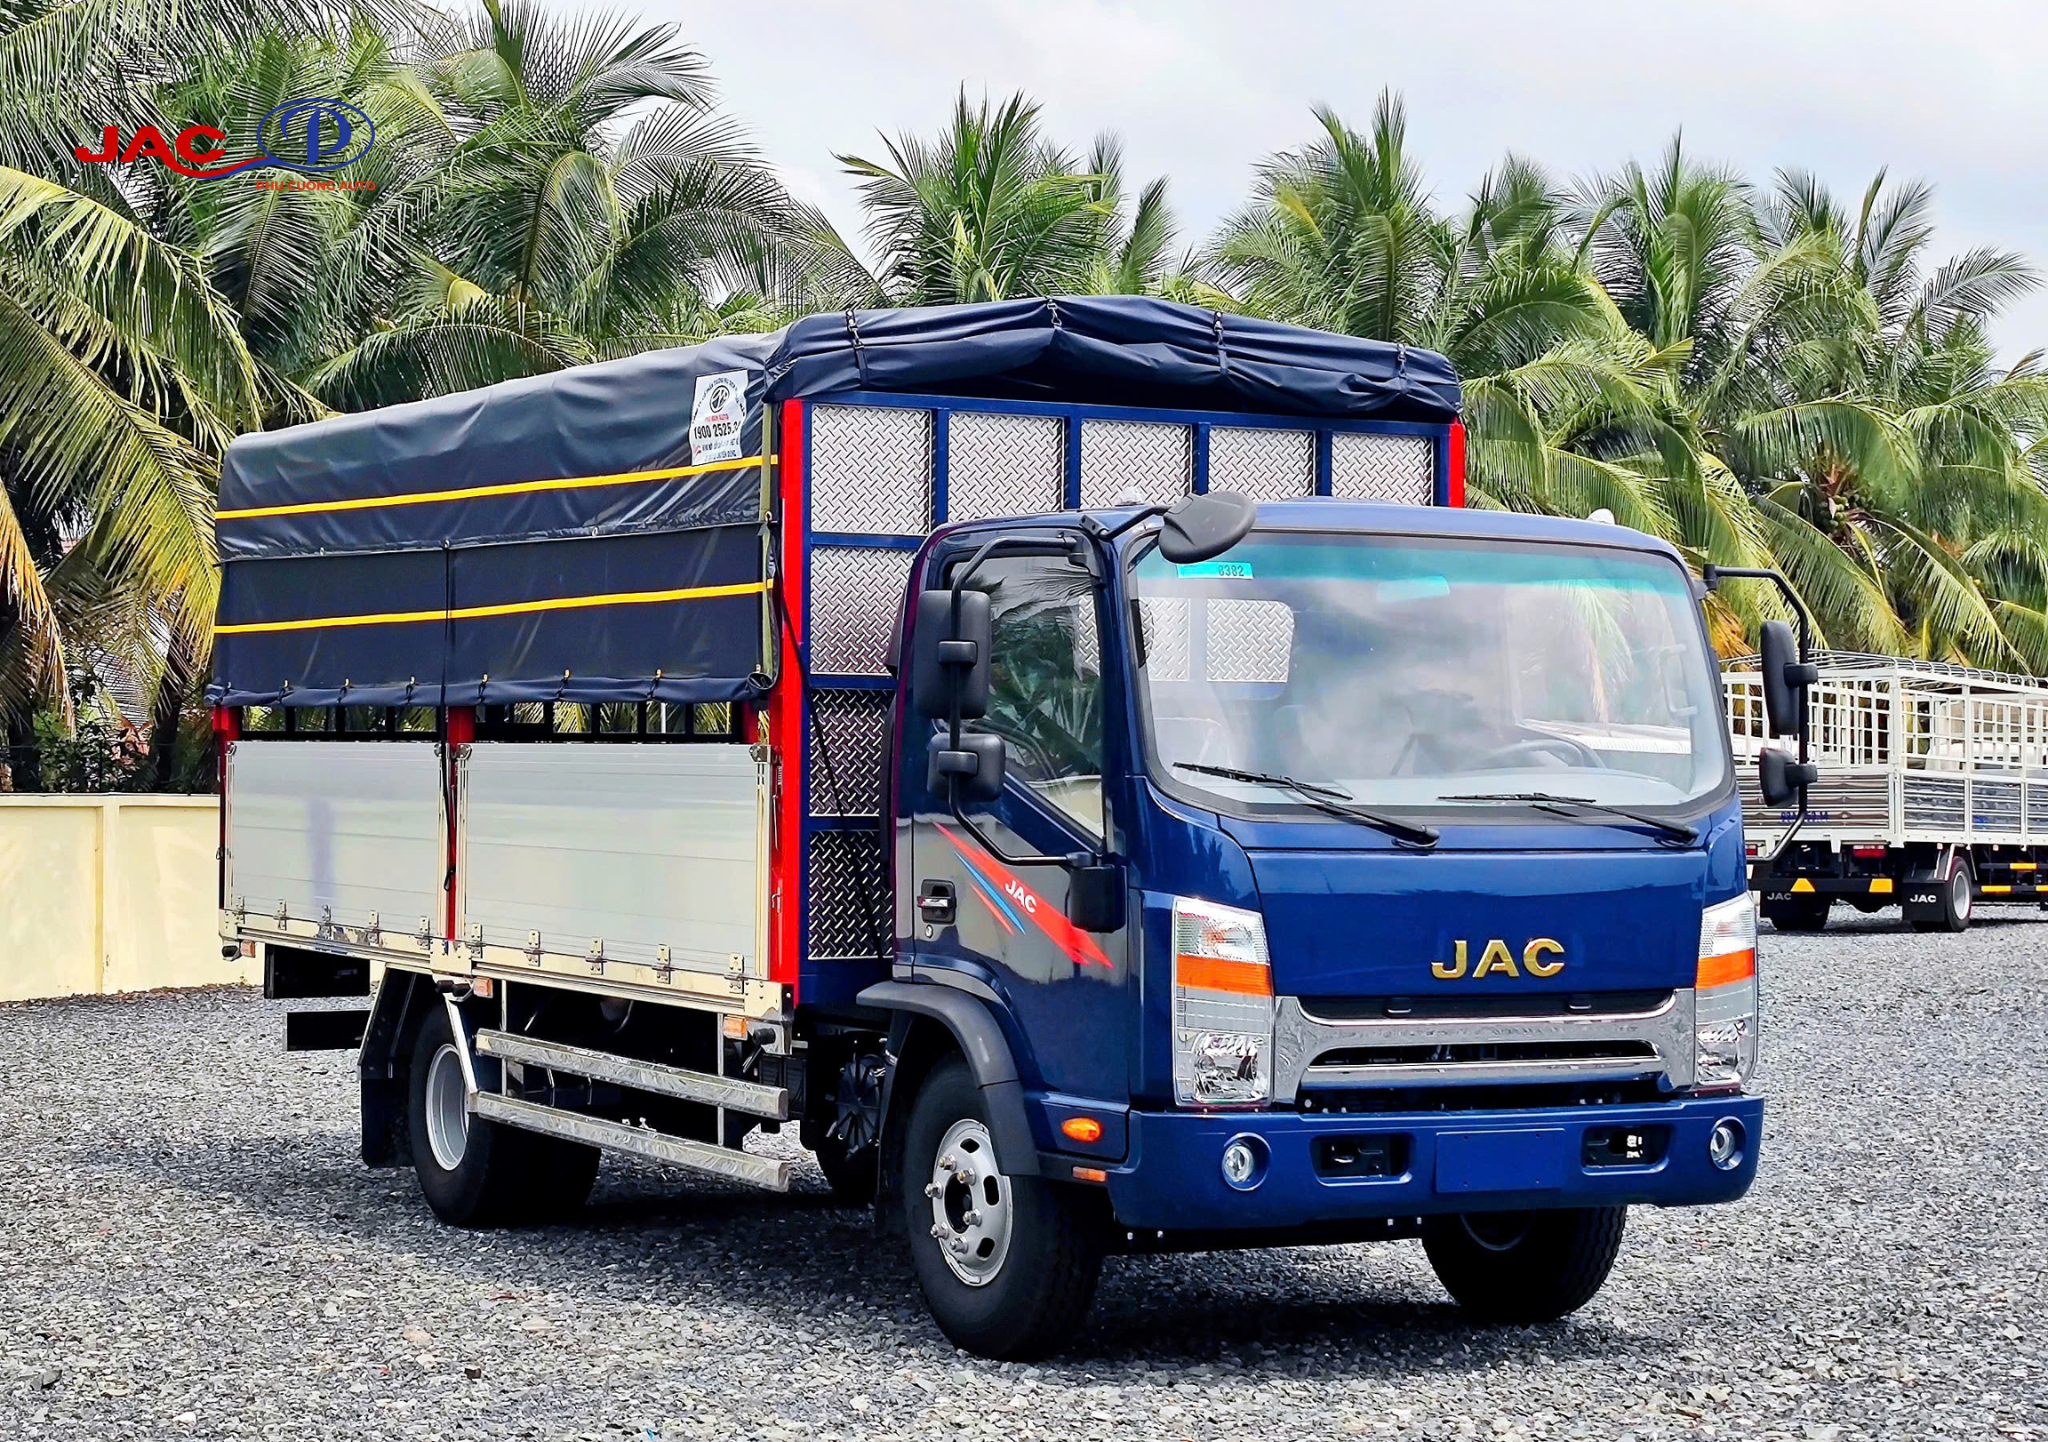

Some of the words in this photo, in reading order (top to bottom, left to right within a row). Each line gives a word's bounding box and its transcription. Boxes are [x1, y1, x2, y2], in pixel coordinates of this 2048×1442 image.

[694, 424, 712, 440] 1900
[1005, 879, 1037, 913] JAC
[1766, 892, 1792, 900] JAC
[1909, 894, 1937, 903] JAC
[1430, 938, 1565, 979] JAC
